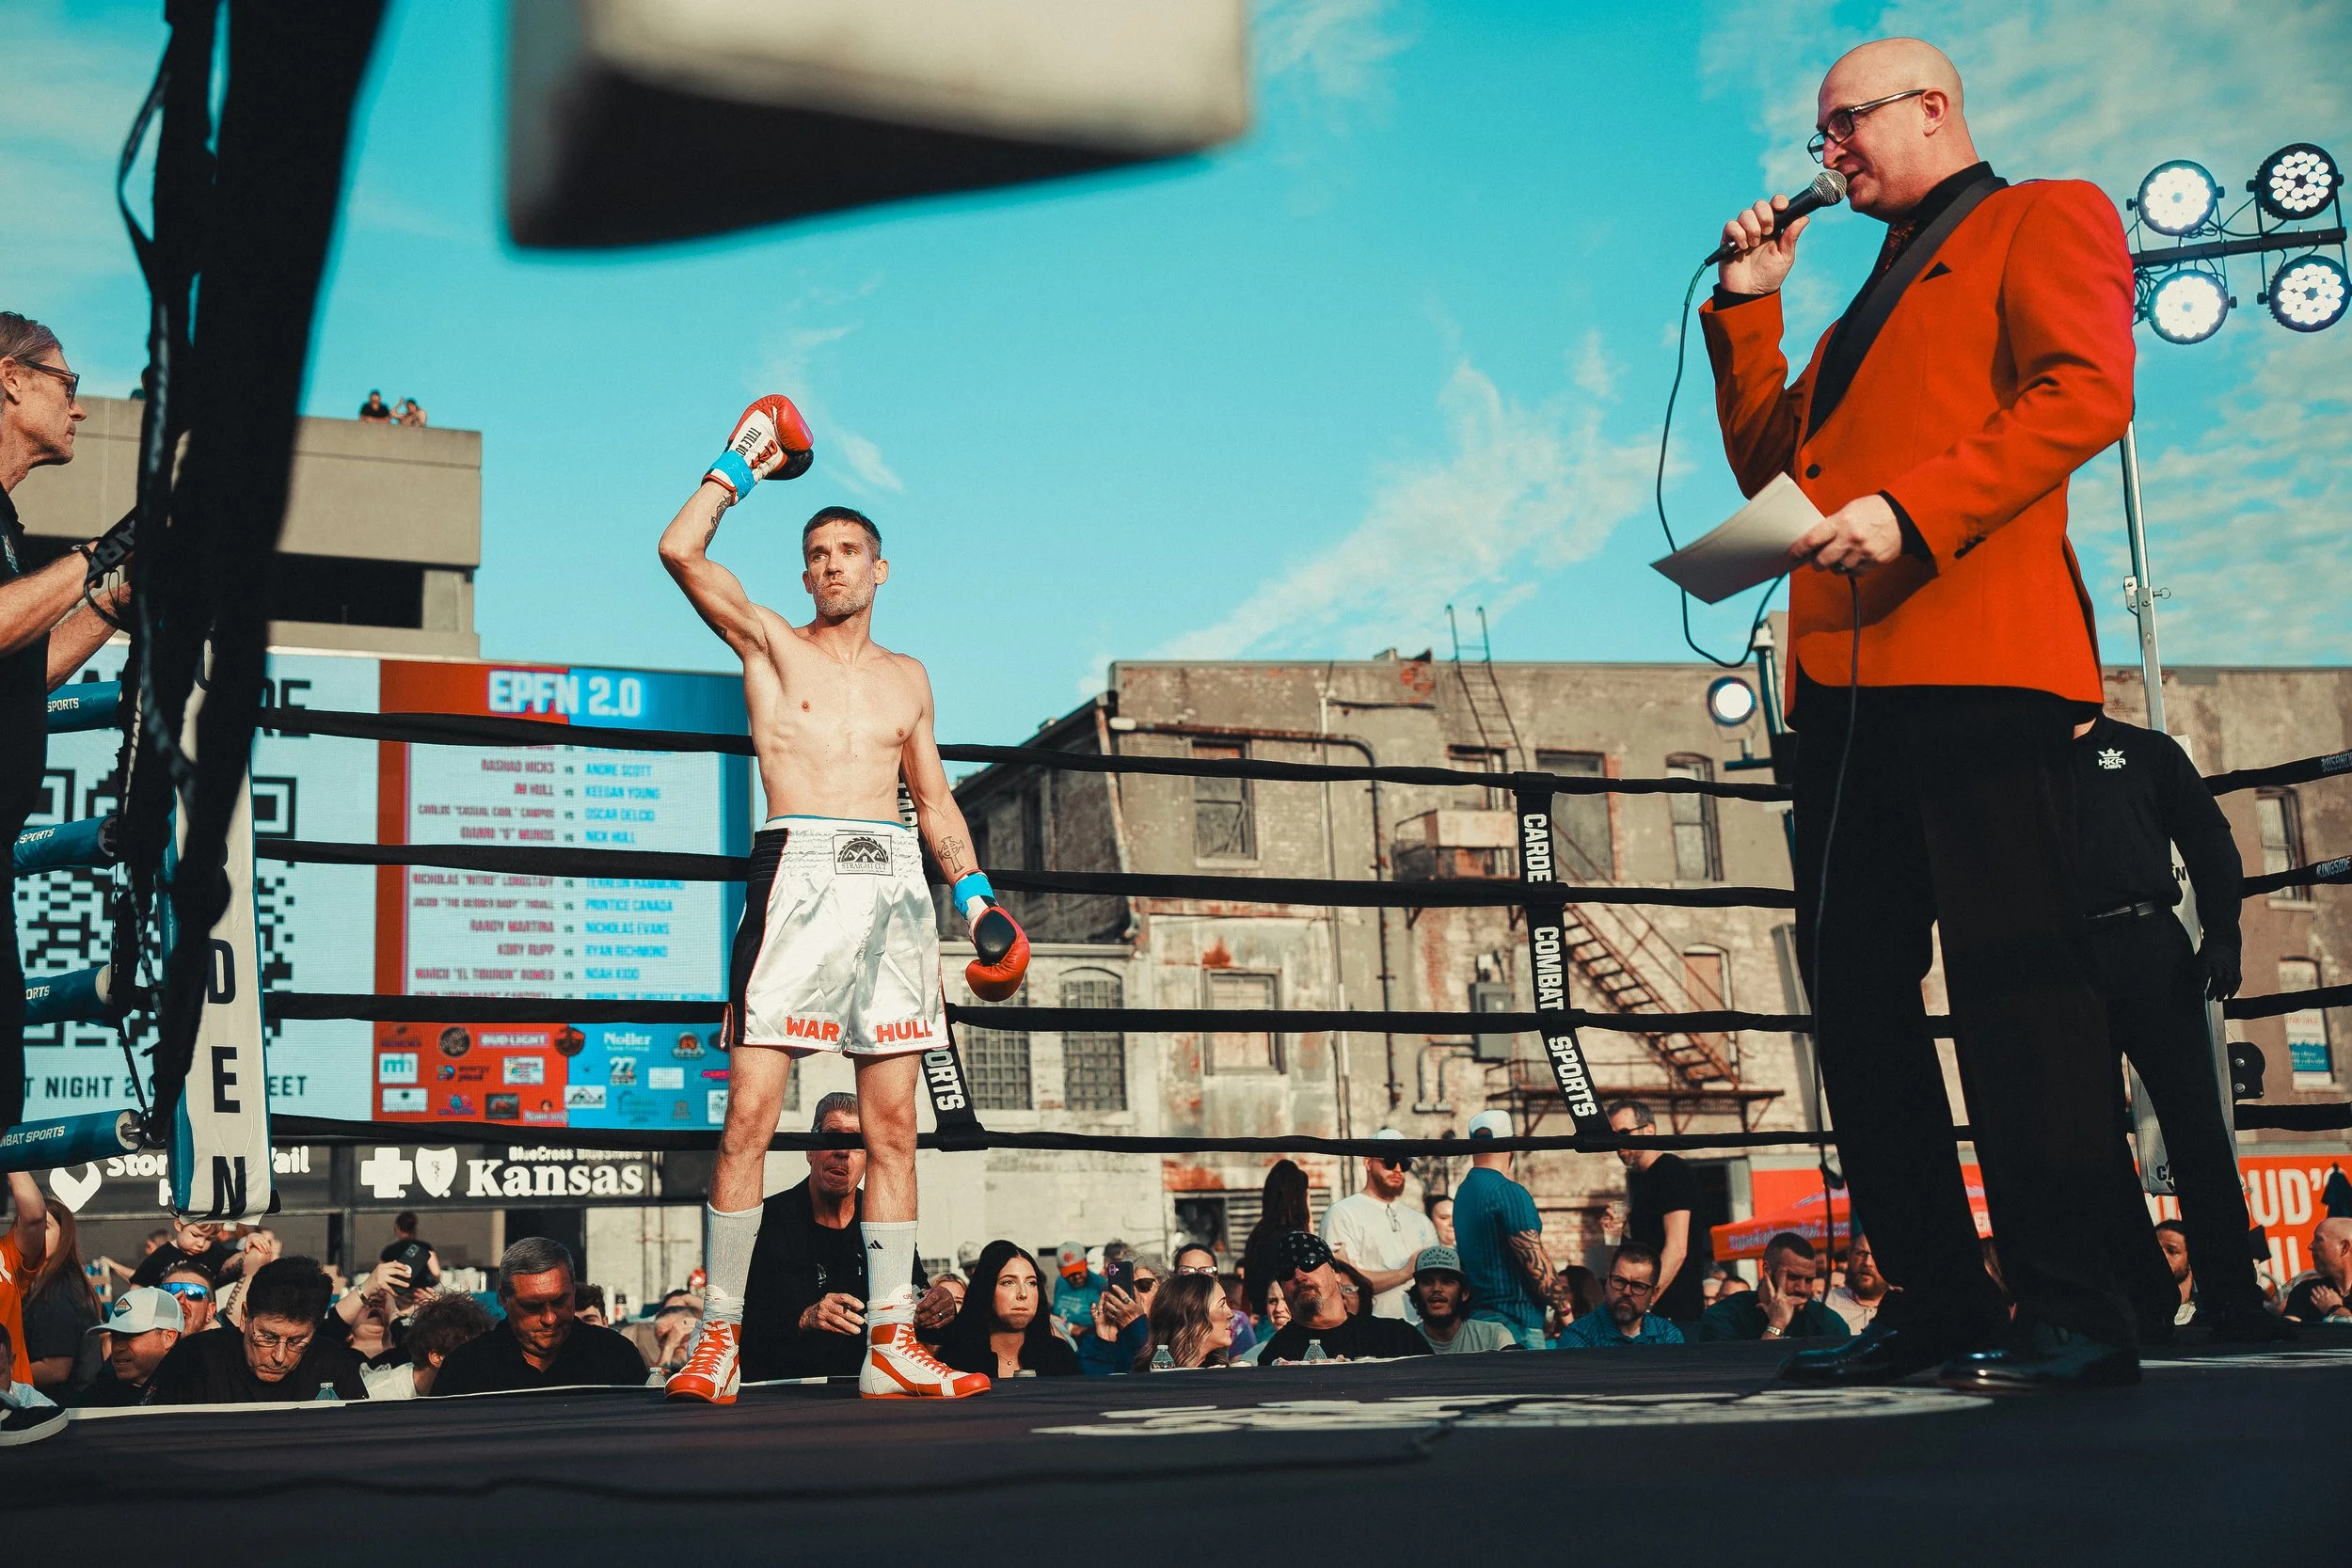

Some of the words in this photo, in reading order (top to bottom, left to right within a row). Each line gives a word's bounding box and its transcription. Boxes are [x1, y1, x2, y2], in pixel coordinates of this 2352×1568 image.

[47, 697, 80, 713] SPORTS
[488, 670, 580, 715] EPFN
[588, 676, 643, 717] 2.0
[19, 828, 56, 845] SPORTS
[1534, 926, 1565, 1011] COMBAT
[787, 1016, 840, 1042] WAR
[876, 1020, 933, 1043] HULL
[47, 1077, 114, 1099] NIGHT
[1548, 1036, 1597, 1117] SPORTS
[25, 1125, 66, 1143] SPORTS
[466, 1159, 645, 1196] Kansas
